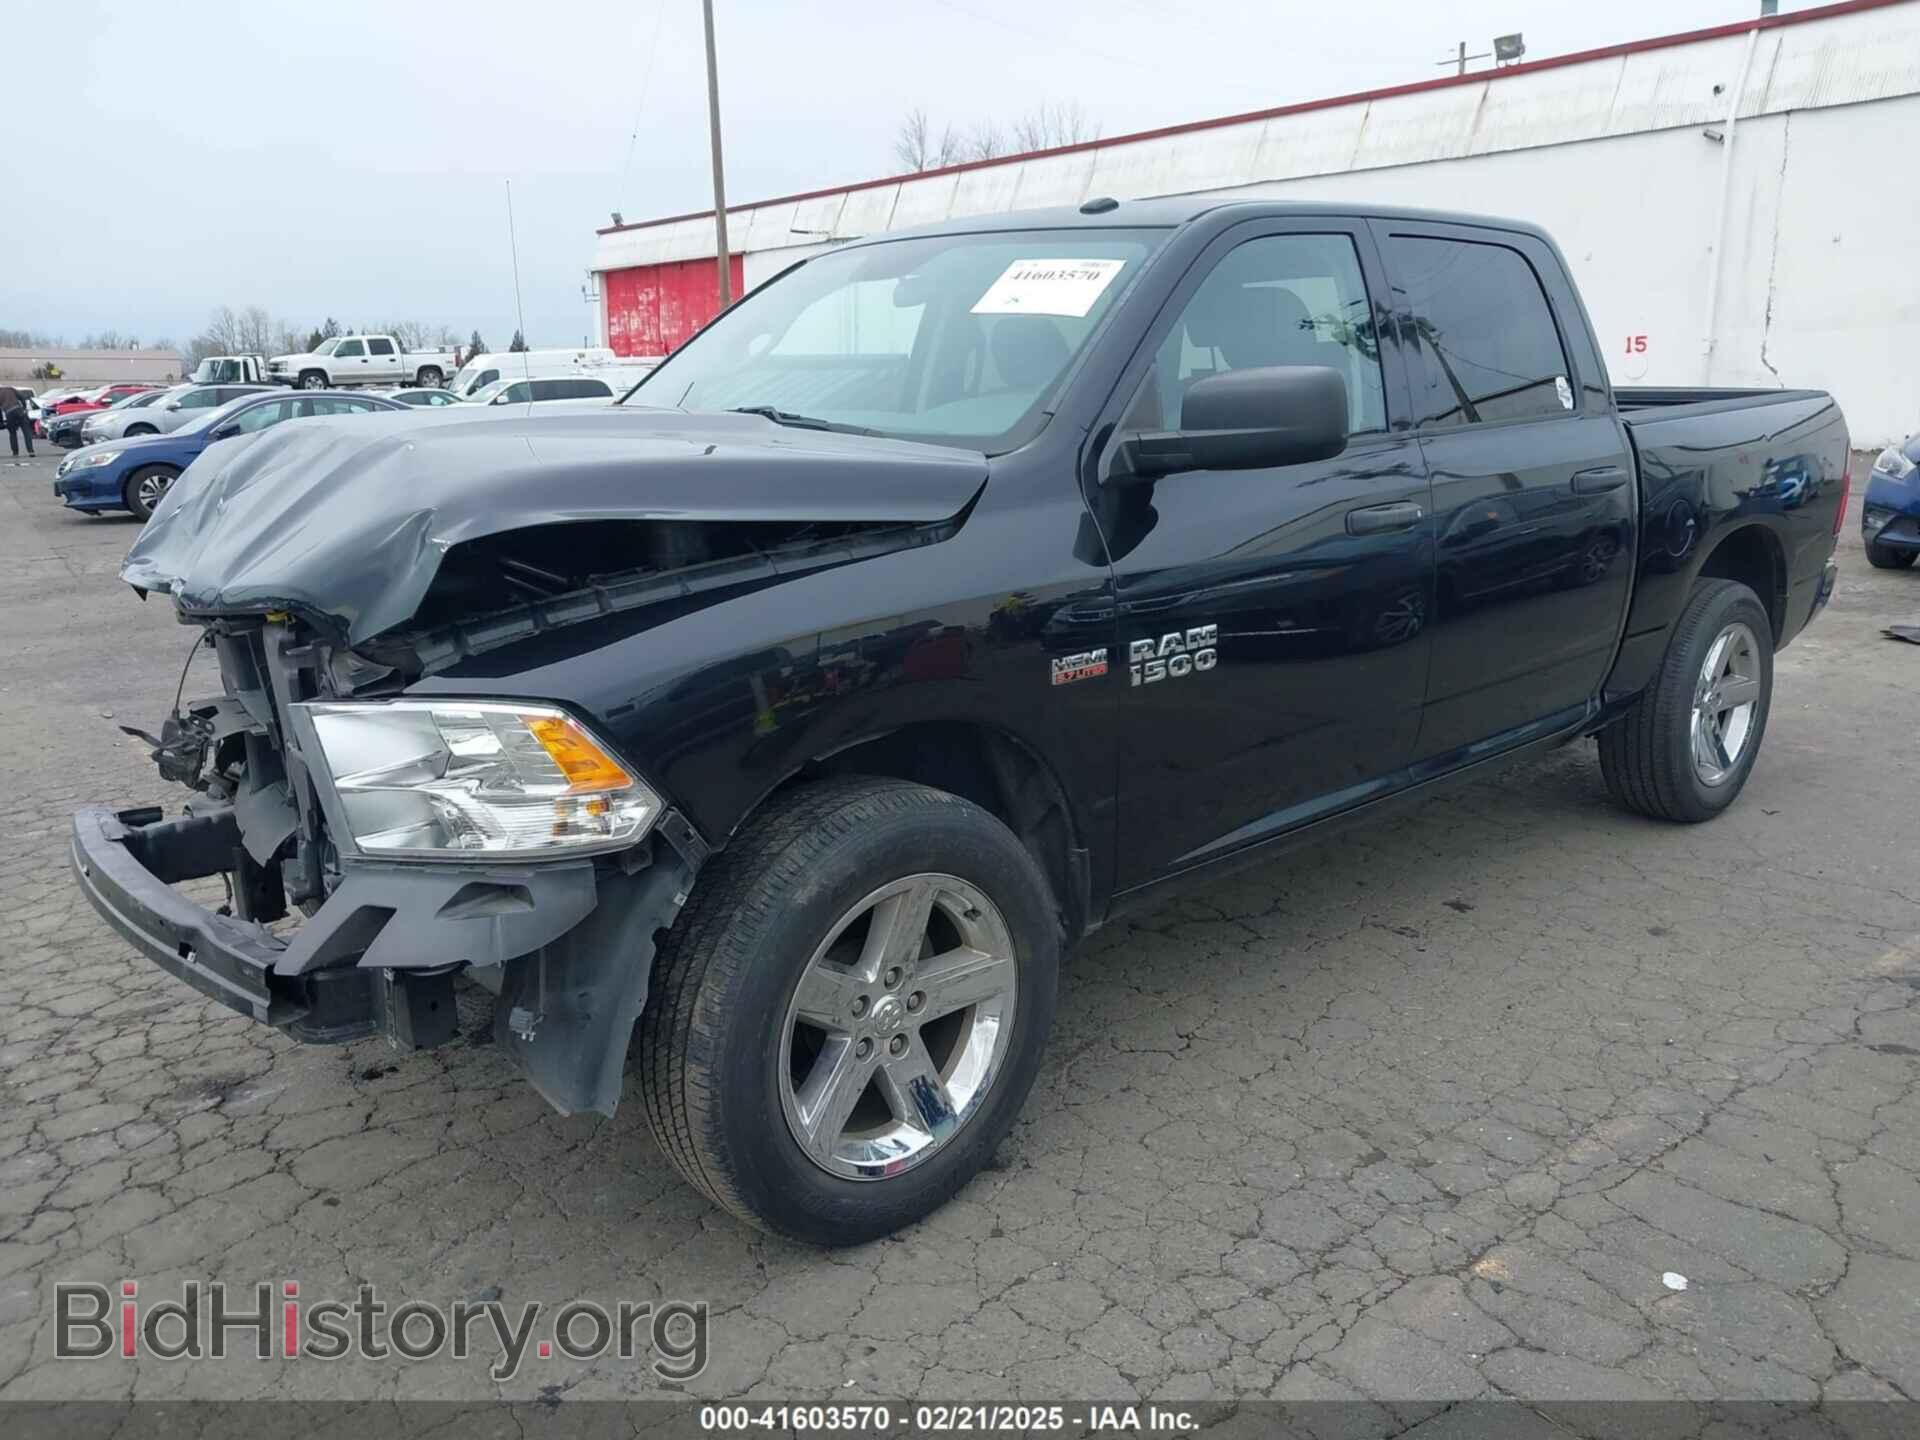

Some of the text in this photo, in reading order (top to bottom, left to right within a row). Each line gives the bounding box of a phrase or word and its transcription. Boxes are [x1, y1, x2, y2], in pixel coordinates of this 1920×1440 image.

[1624, 335, 1648, 354] 15
[1129, 623, 1218, 664] RAM
[1051, 648, 1108, 673] HEMI
[1130, 647, 1218, 687] 1500
